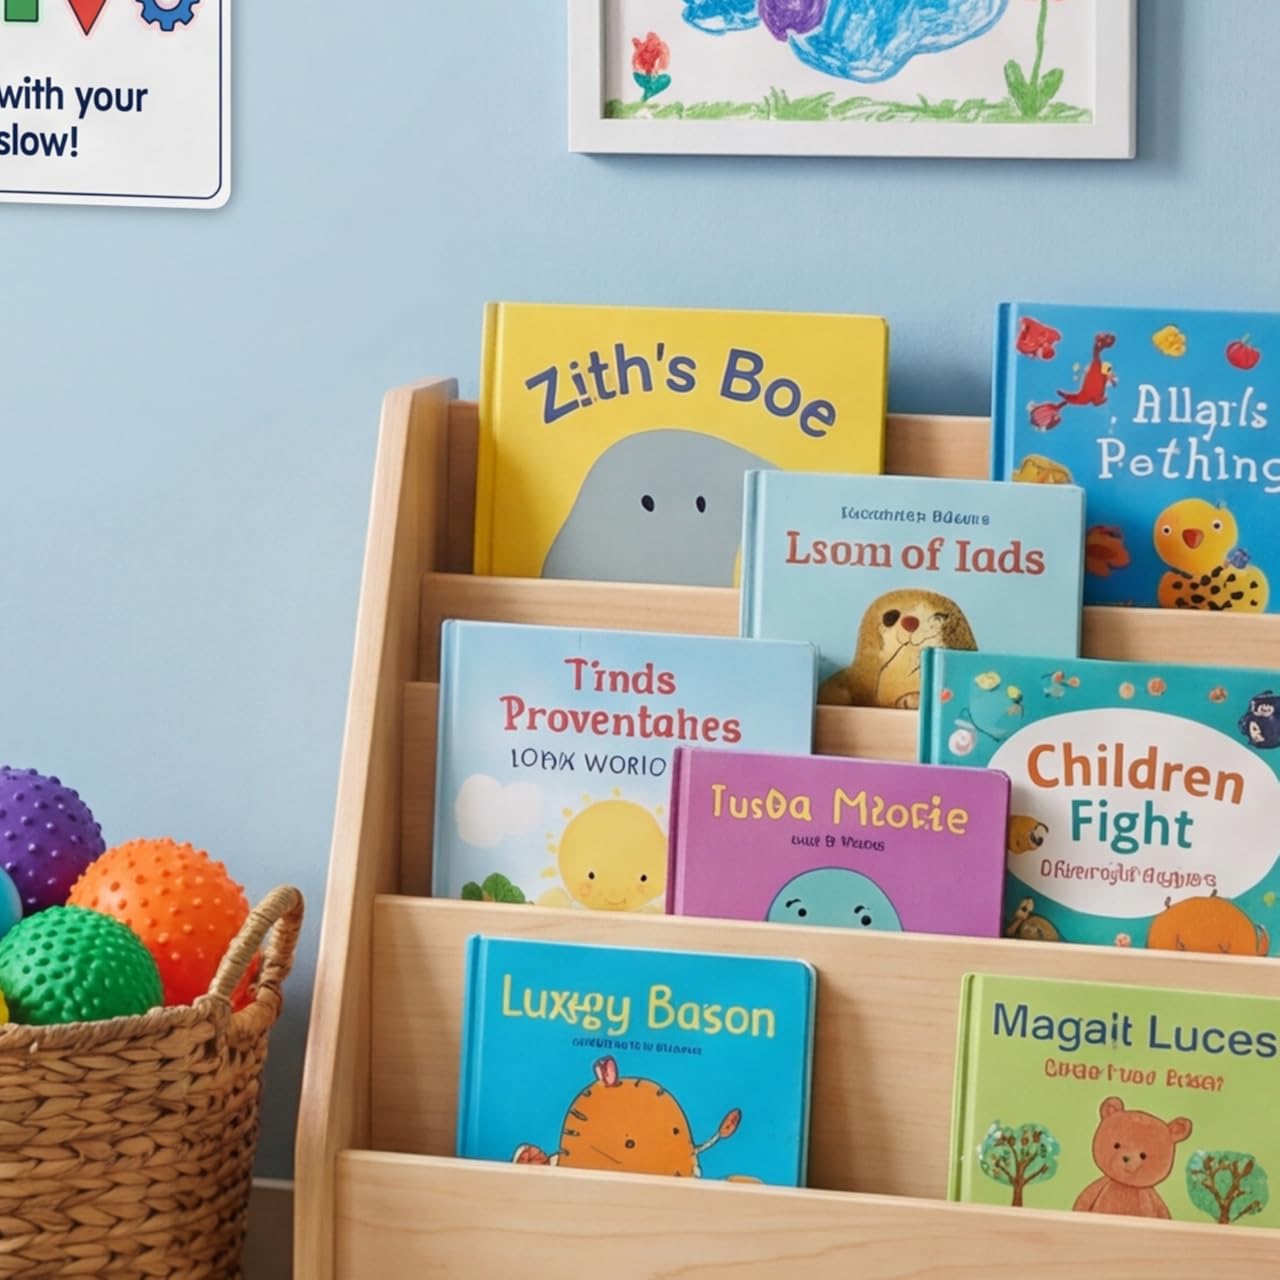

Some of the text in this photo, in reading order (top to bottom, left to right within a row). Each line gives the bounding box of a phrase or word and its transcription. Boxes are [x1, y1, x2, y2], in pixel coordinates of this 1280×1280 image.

[74, 86, 148, 119] your
[720, 347, 837, 438] Boe
[785, 530, 893, 569] Lsom
[901, 536, 945, 571] of
[564, 657, 677, 695] Tinds
[499, 694, 742, 744] Proventahes
[1027, 742, 1245, 805] Children
[1071, 799, 1194, 854] Fight
[647, 984, 776, 1038] Bason
[993, 1002, 1277, 1058] Magait Luces
